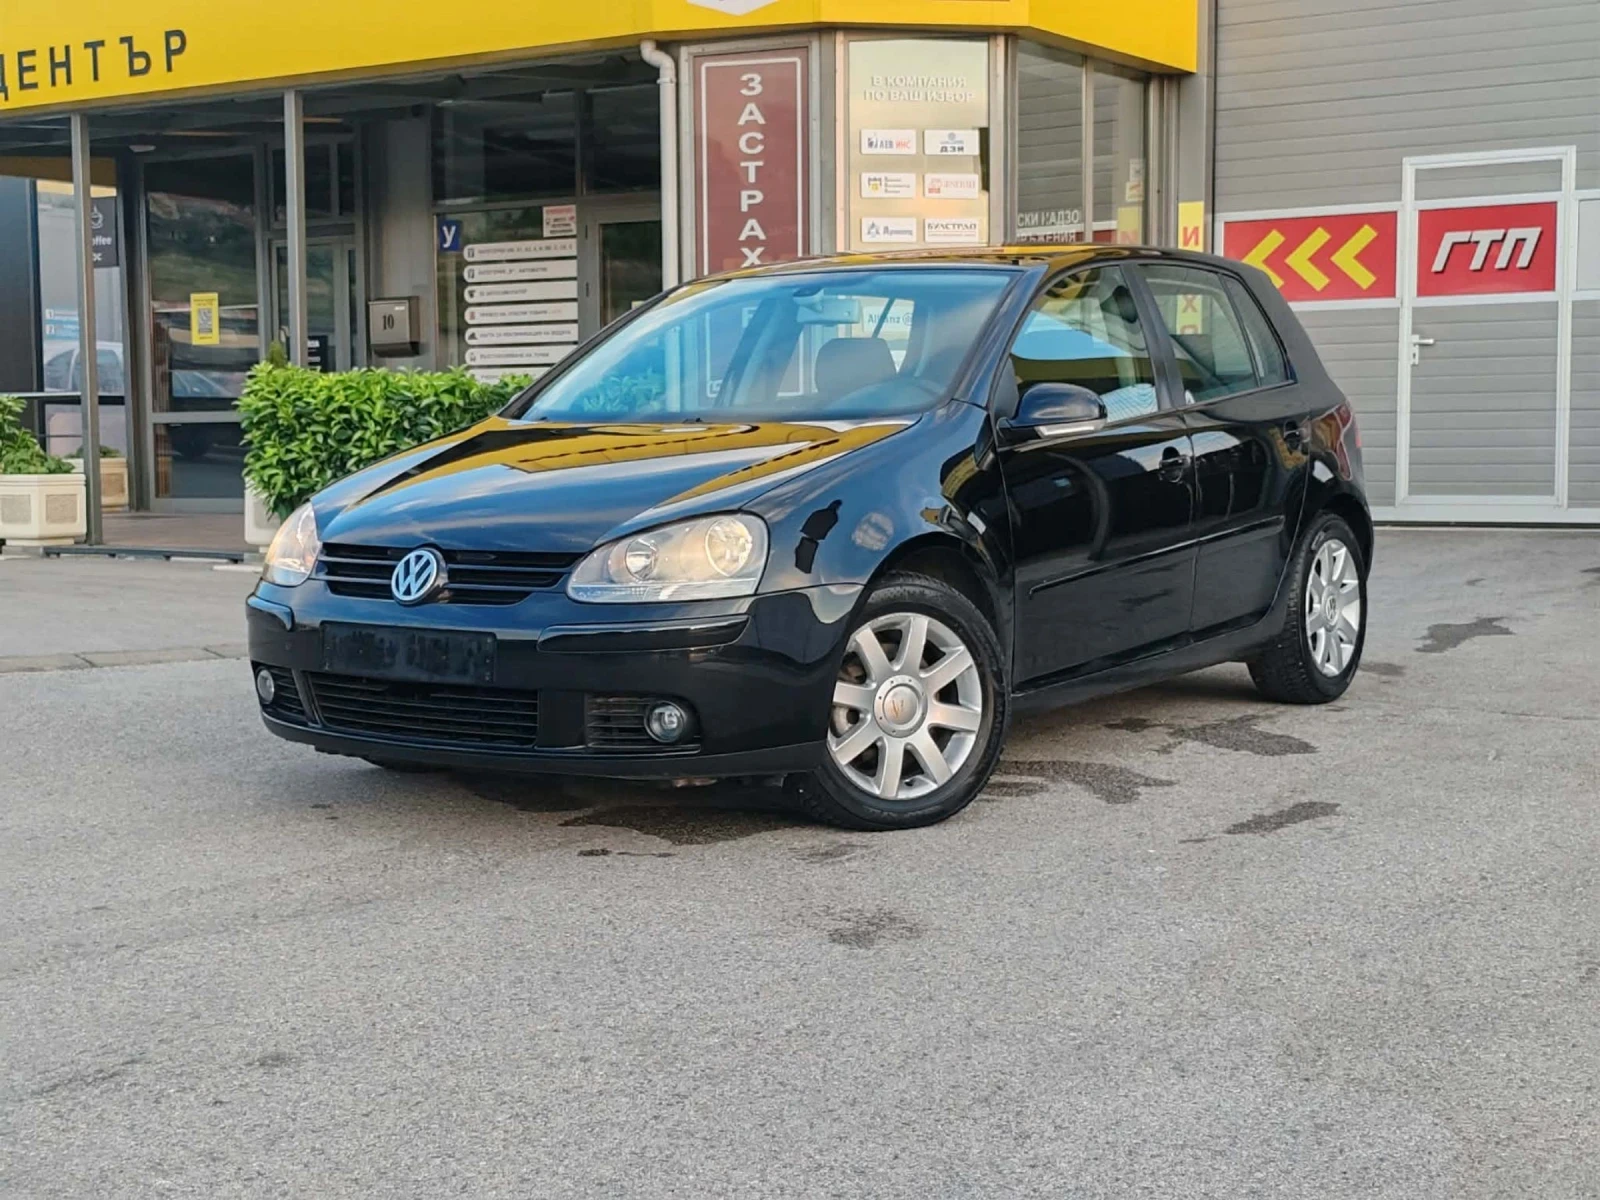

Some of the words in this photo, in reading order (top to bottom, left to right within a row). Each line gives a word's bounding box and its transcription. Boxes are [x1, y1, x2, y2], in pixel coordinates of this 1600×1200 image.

[886, 75, 966, 88] КОМПАНИЯ
[888, 90, 920, 102] ВАШ
[1431, 227, 1542, 273] ГТП
[382, 314, 395, 331] 10
